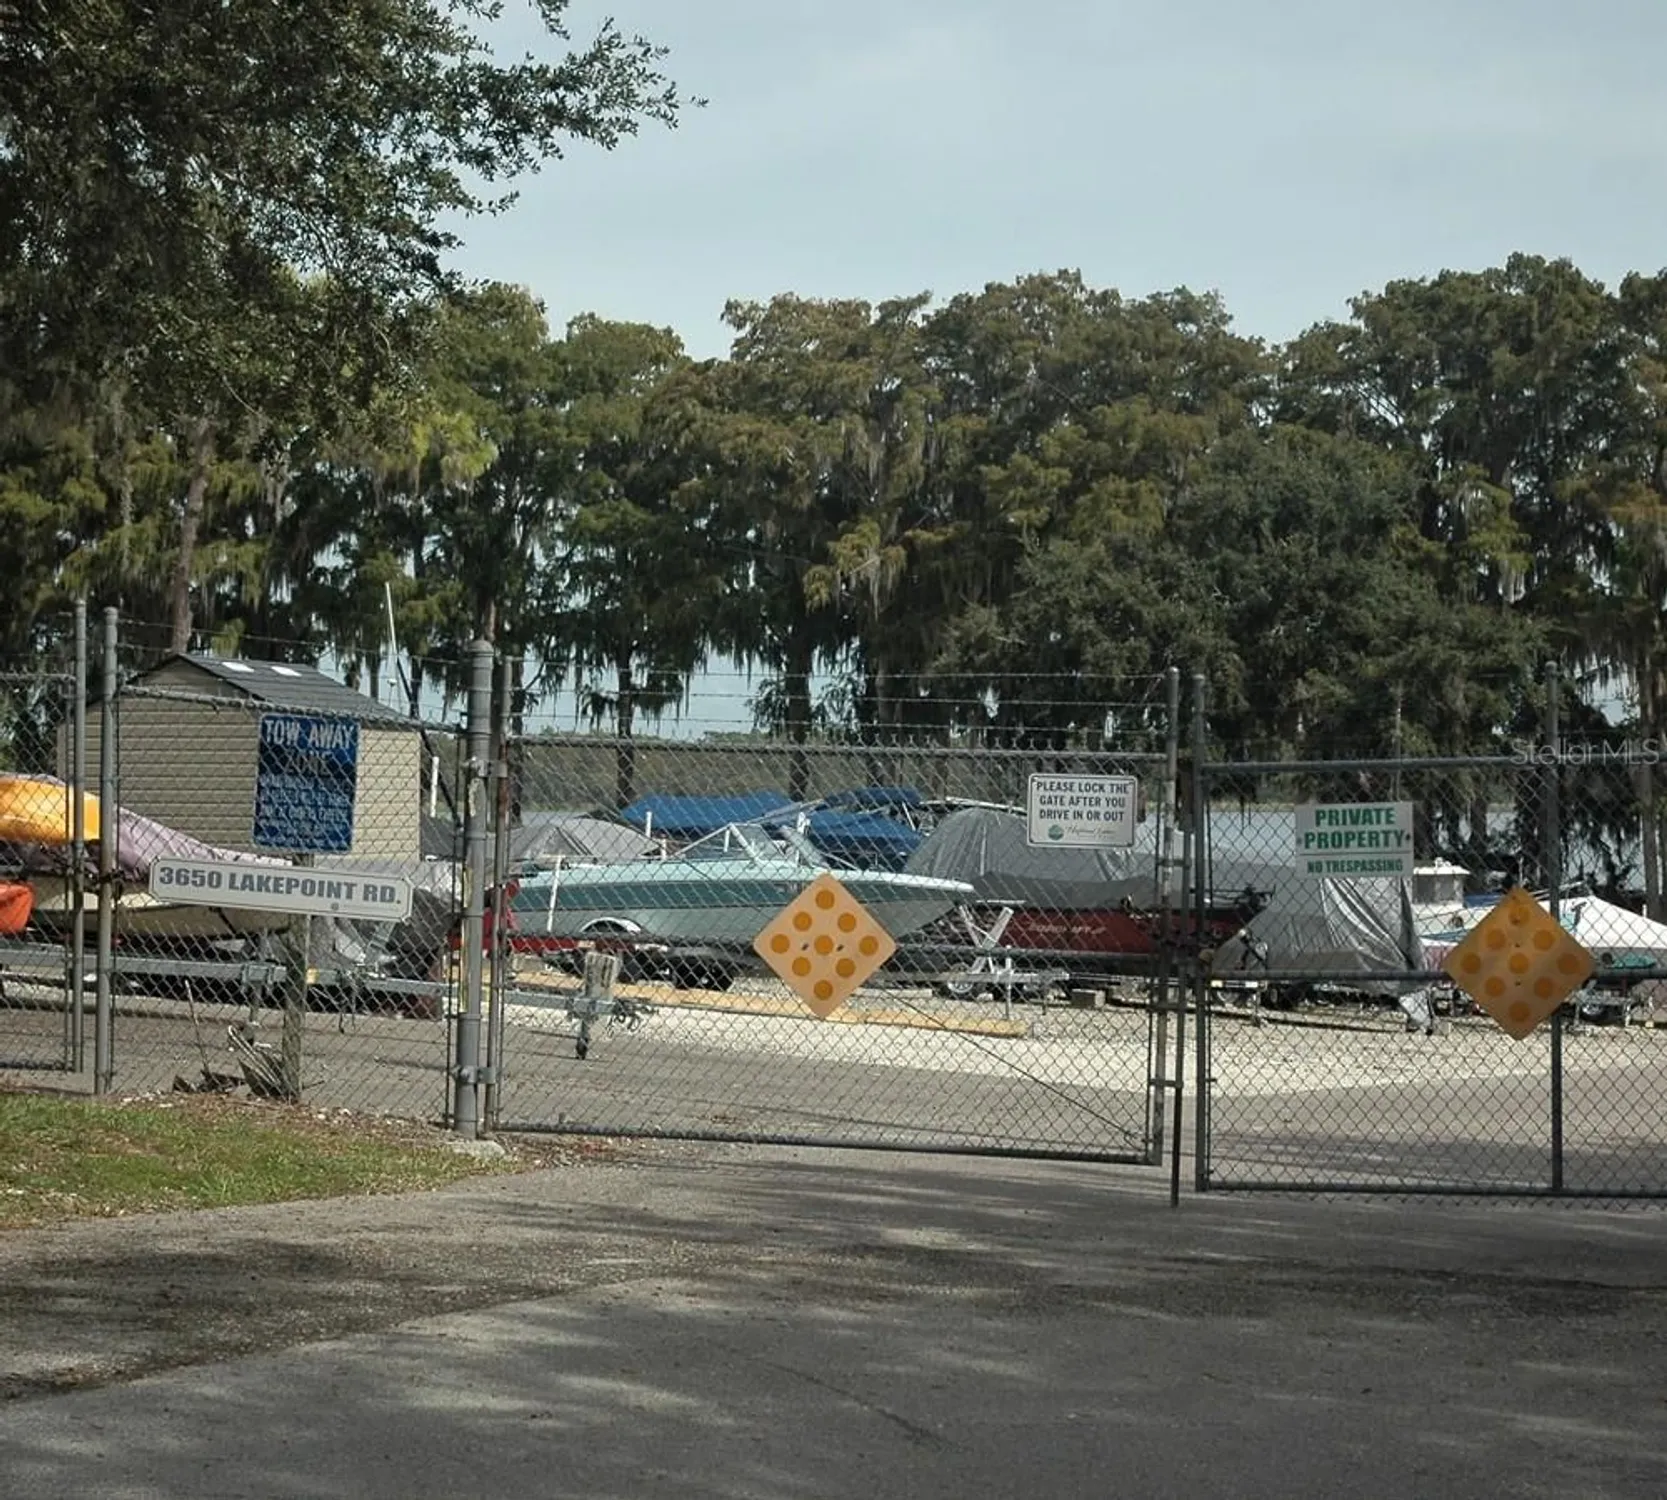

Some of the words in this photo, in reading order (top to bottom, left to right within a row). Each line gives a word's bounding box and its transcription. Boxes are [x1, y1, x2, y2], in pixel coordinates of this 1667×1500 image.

[264, 719, 301, 745] TOW
[308, 723, 355, 749] AWAY
[1036, 781, 1076, 792] PLEASE
[1078, 782, 1106, 793] LOCK
[1110, 783, 1129, 794] THE
[1039, 795, 1065, 806] GATE
[1068, 796, 1101, 807] AFTER
[1105, 797, 1126, 808] YOU
[1039, 809, 1070, 820] DRIVE
[1073, 810, 1083, 820] IN
[1086, 810, 1101, 821] OR
[1103, 811, 1125, 821] OUT
[1315, 807, 1395, 827] PRIVATE
[1304, 829, 1405, 849] PROPERTY
[1307, 860, 1323, 874] NO
[1326, 859, 1403, 873] TRESPASSING
[159, 866, 222, 889] 3650
[228, 872, 357, 900] LAKEPOINT
[362, 884, 401, 905] RD.
